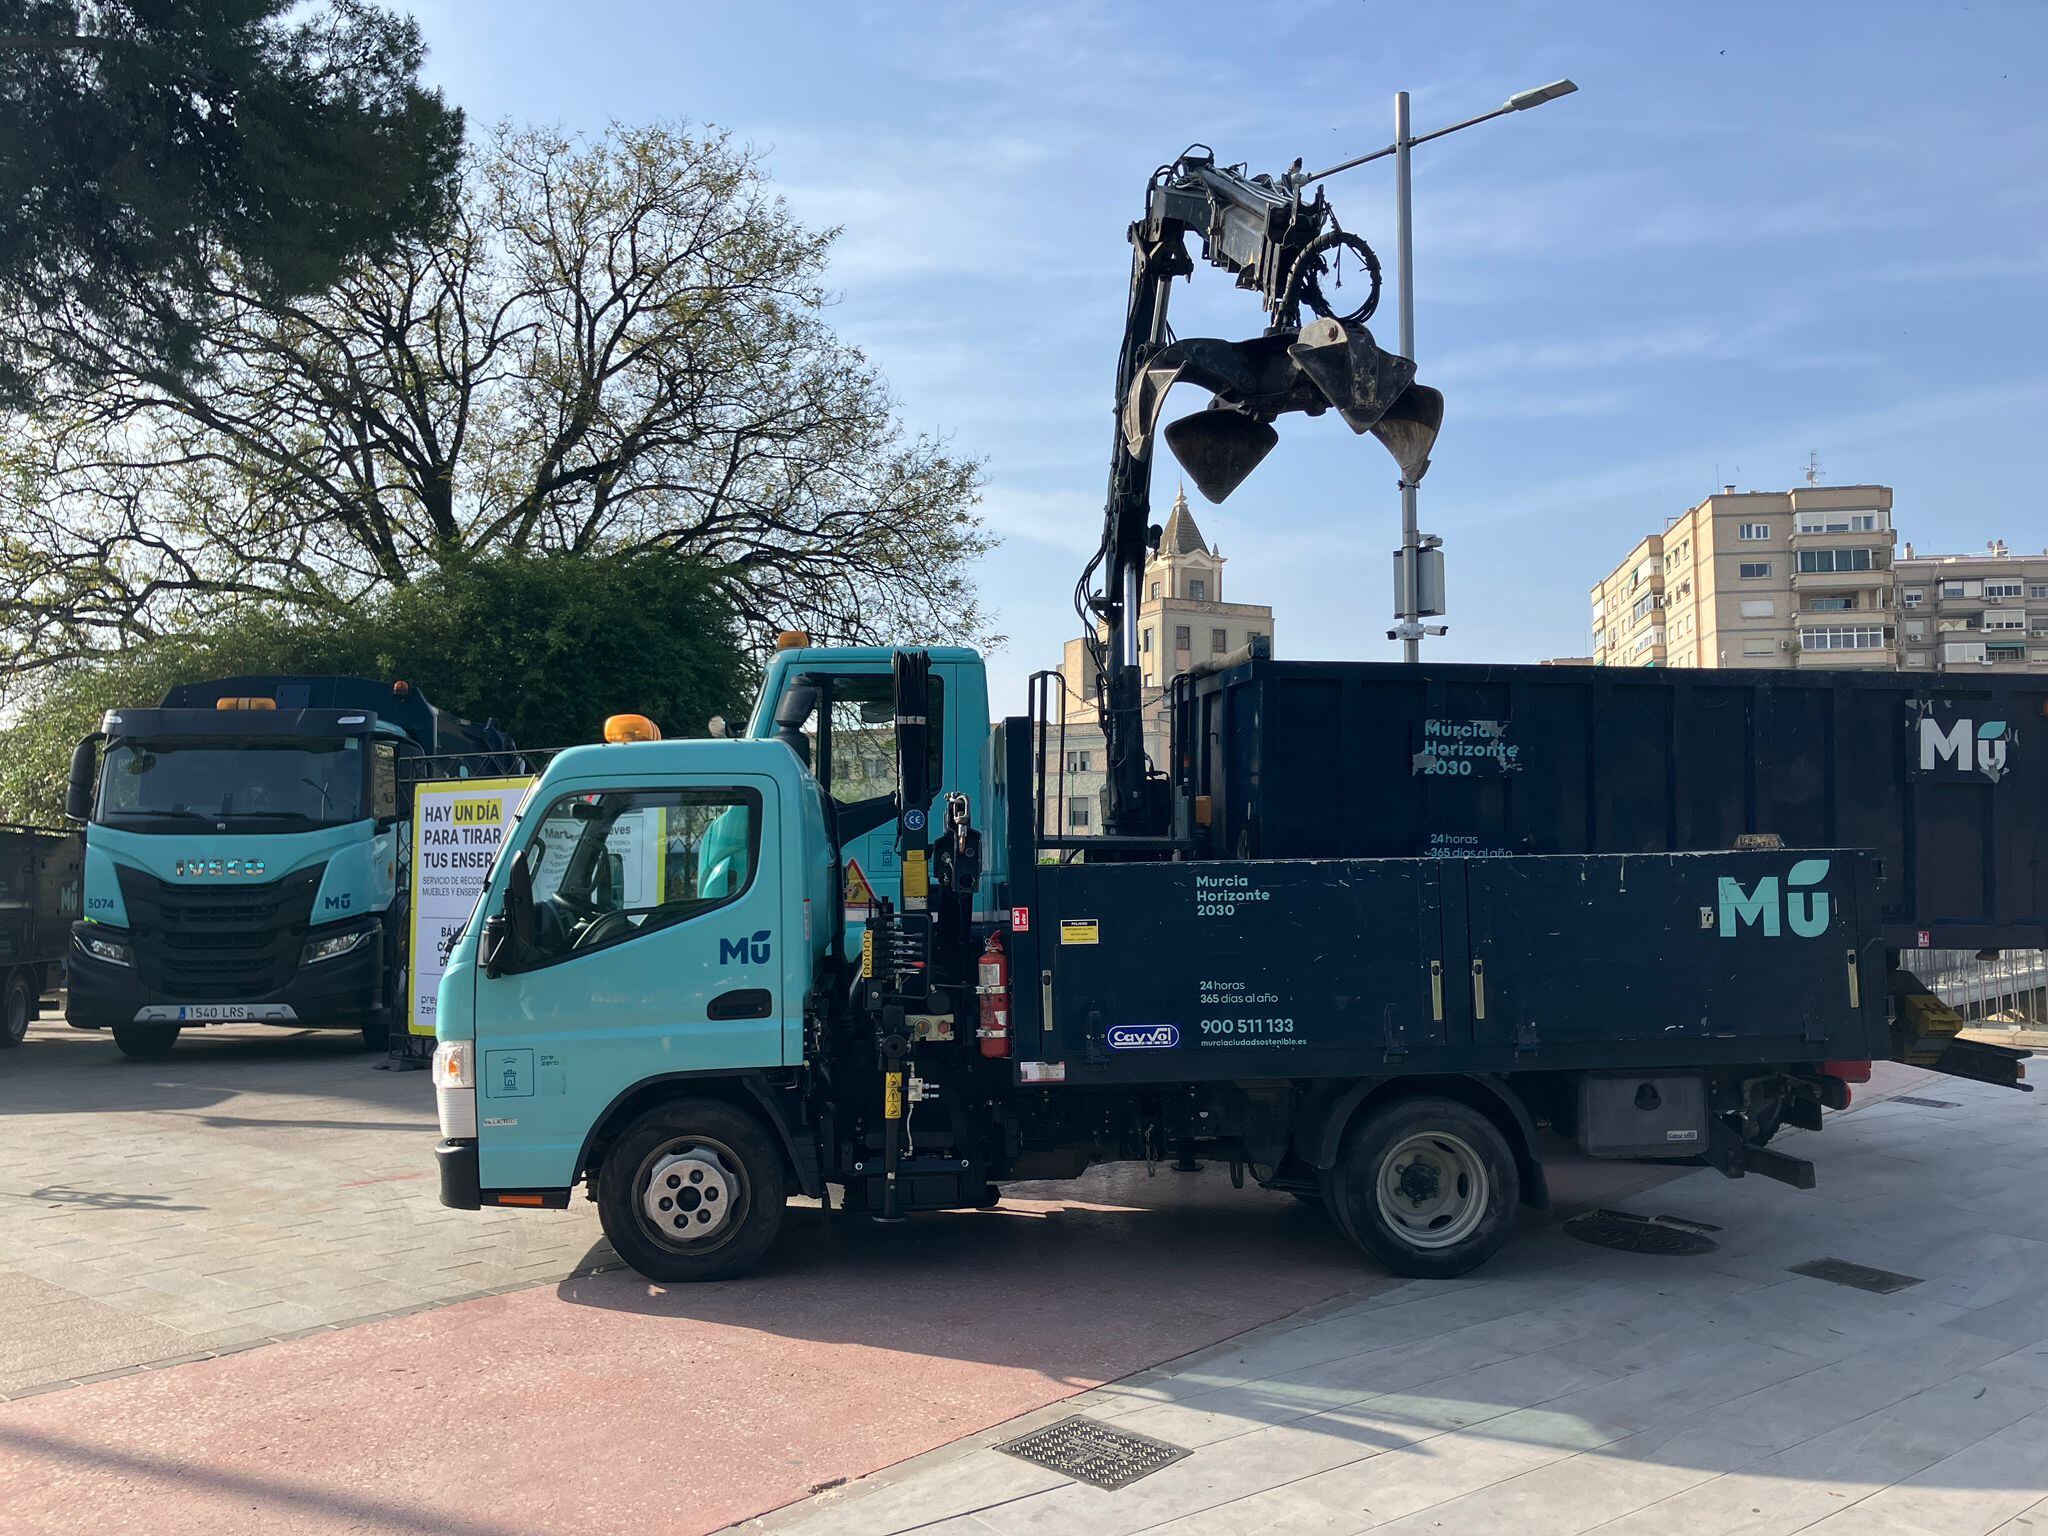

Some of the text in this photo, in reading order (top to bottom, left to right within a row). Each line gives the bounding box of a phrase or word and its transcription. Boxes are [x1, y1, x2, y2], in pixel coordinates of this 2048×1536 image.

[1425, 721, 1494, 737] Murcia
[1424, 740, 1518, 757] Horizonte
[425, 800, 499, 822] HAY UN DÍA
[424, 828, 501, 845] PARA TIRAR
[1430, 833, 1478, 844] 24 horas
[1431, 847, 1513, 857] 365 días al año
[424, 851, 495, 868] TUS ENSER
[176, 859, 265, 877] IVECO
[423, 876, 483, 885] SERVICIO DE RECOG
[1196, 875, 1248, 888] Murcia
[423, 887, 450, 896] MUEBLES
[1196, 889, 1270, 902] Horizonte
[88, 899, 114, 909] 5074
[1197, 904, 1235, 916] 2030
[1200, 981, 1245, 990] 24 horas
[1200, 993, 1278, 1003] 365 días al año
[189, 1006, 244, 1019] 1540 LRS
[1201, 1018, 1294, 1034] 900 511 133
[1201, 1038, 1307, 1047] murciaciudadsostenible.es
